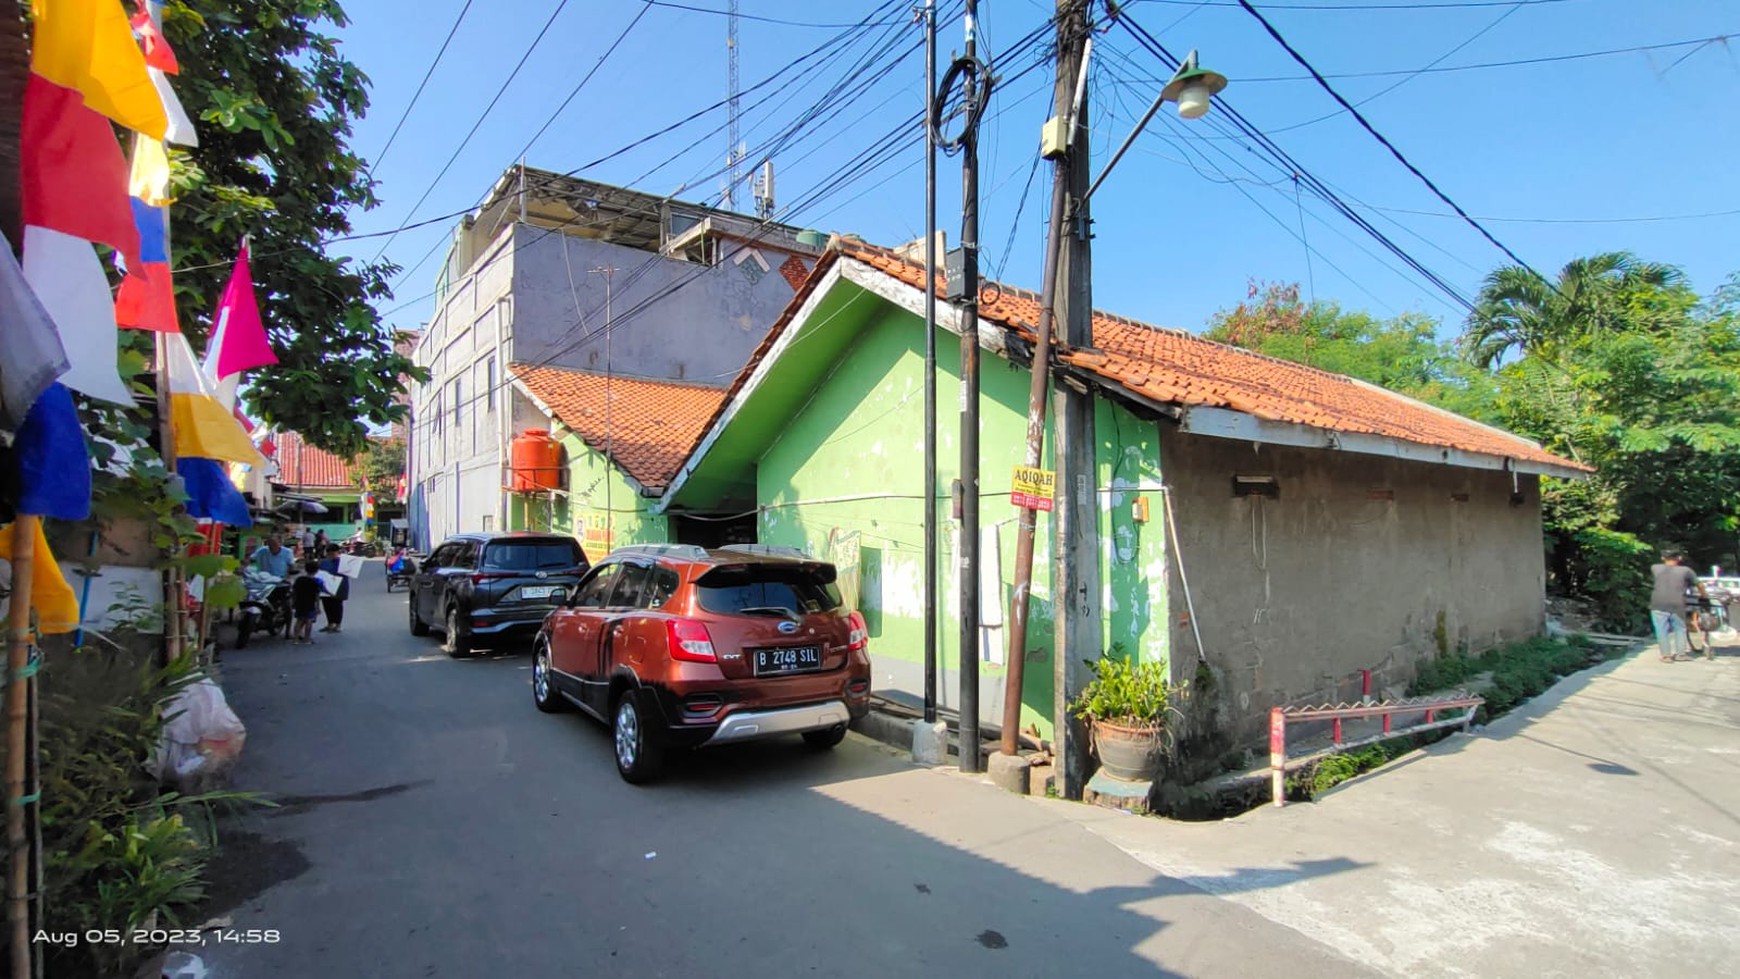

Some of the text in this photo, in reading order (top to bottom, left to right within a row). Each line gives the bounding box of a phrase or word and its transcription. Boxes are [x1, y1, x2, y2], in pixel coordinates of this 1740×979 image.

[1015, 469, 1052, 486] AQIQAH
[760, 652, 766, 666] B
[773, 650, 797, 665] 2748
[800, 649, 816, 662] SIL
